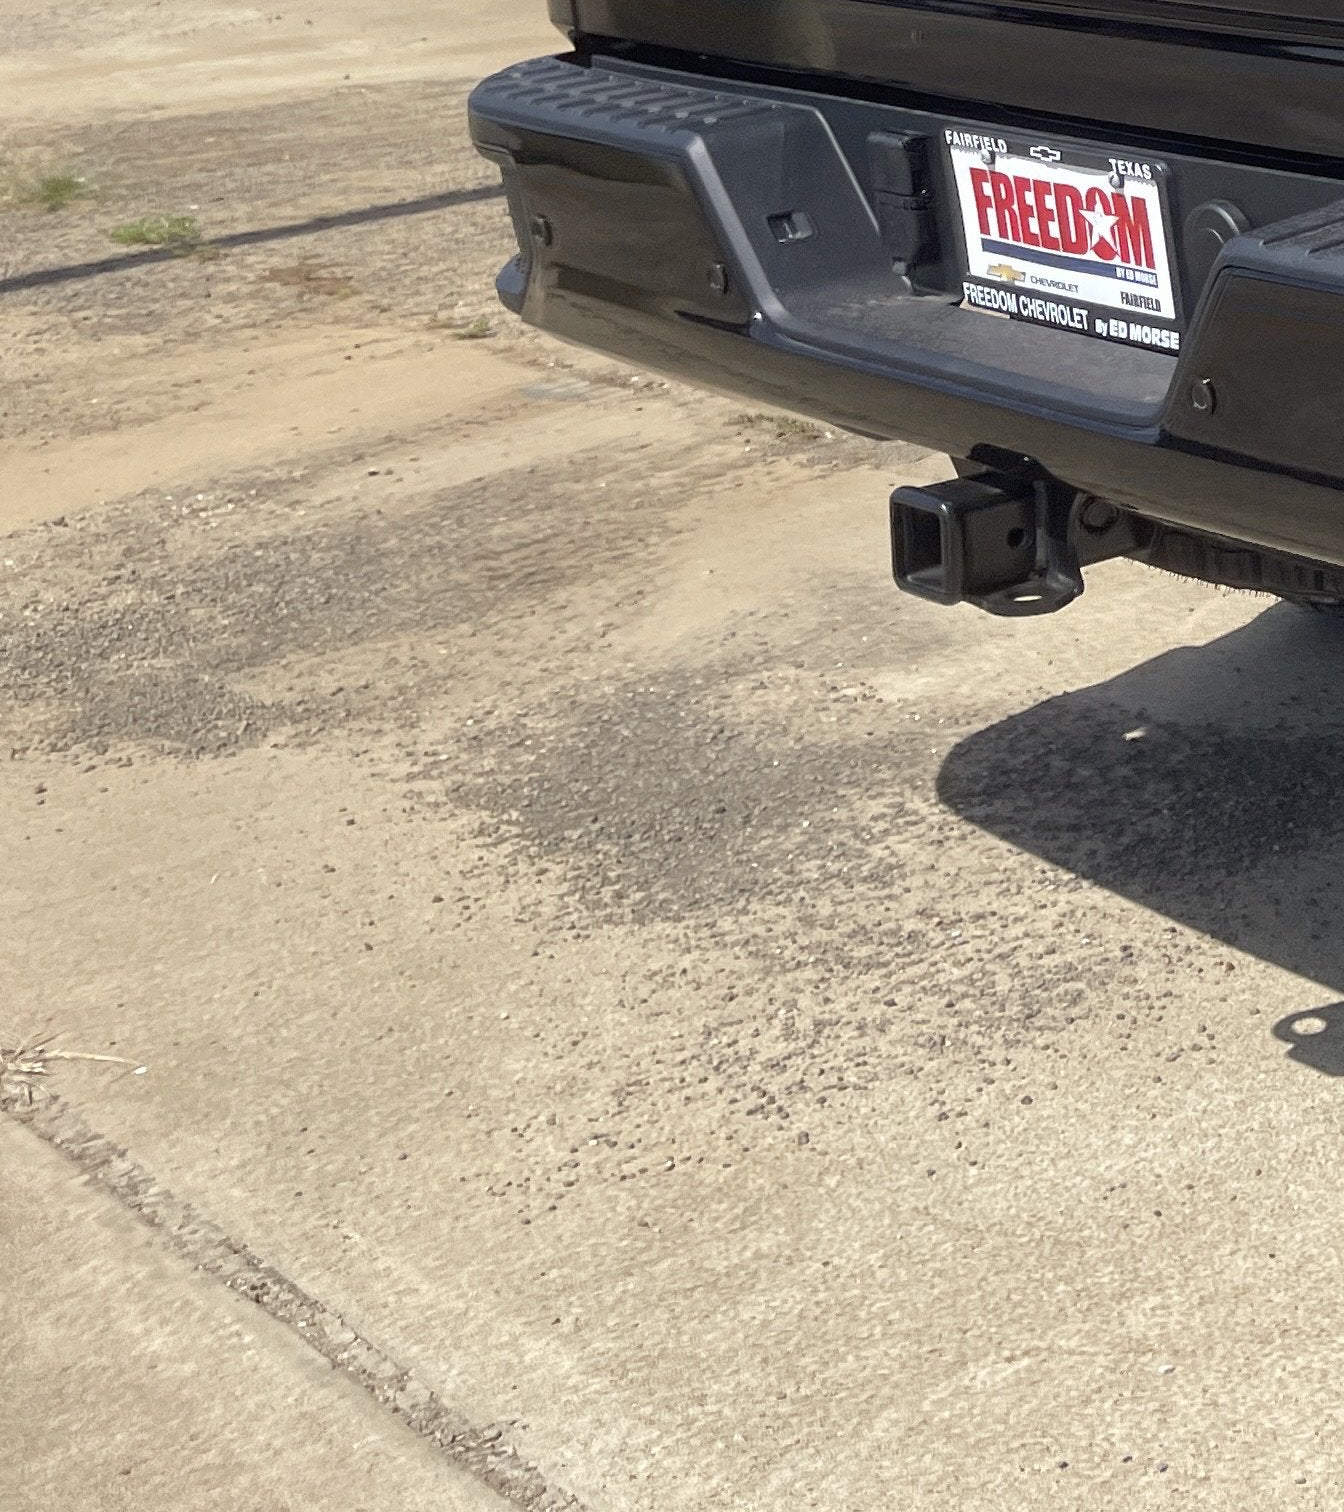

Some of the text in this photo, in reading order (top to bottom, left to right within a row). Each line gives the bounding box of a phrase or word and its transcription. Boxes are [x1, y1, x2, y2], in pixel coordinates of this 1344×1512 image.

[944, 129, 1008, 154] FAIRFIELD
[1107, 157, 1152, 180] TEXAS
[969, 166, 1157, 270] FREEDOM
[1029, 274, 1079, 294] CHEVROLET
[1121, 291, 1161, 312] FAIRFIELD
[962, 281, 1018, 314] FREEDOM
[1018, 293, 1089, 330] CHEVROLET
[1108, 318, 1128, 339] ED
[1129, 322, 1181, 350] MORSE
